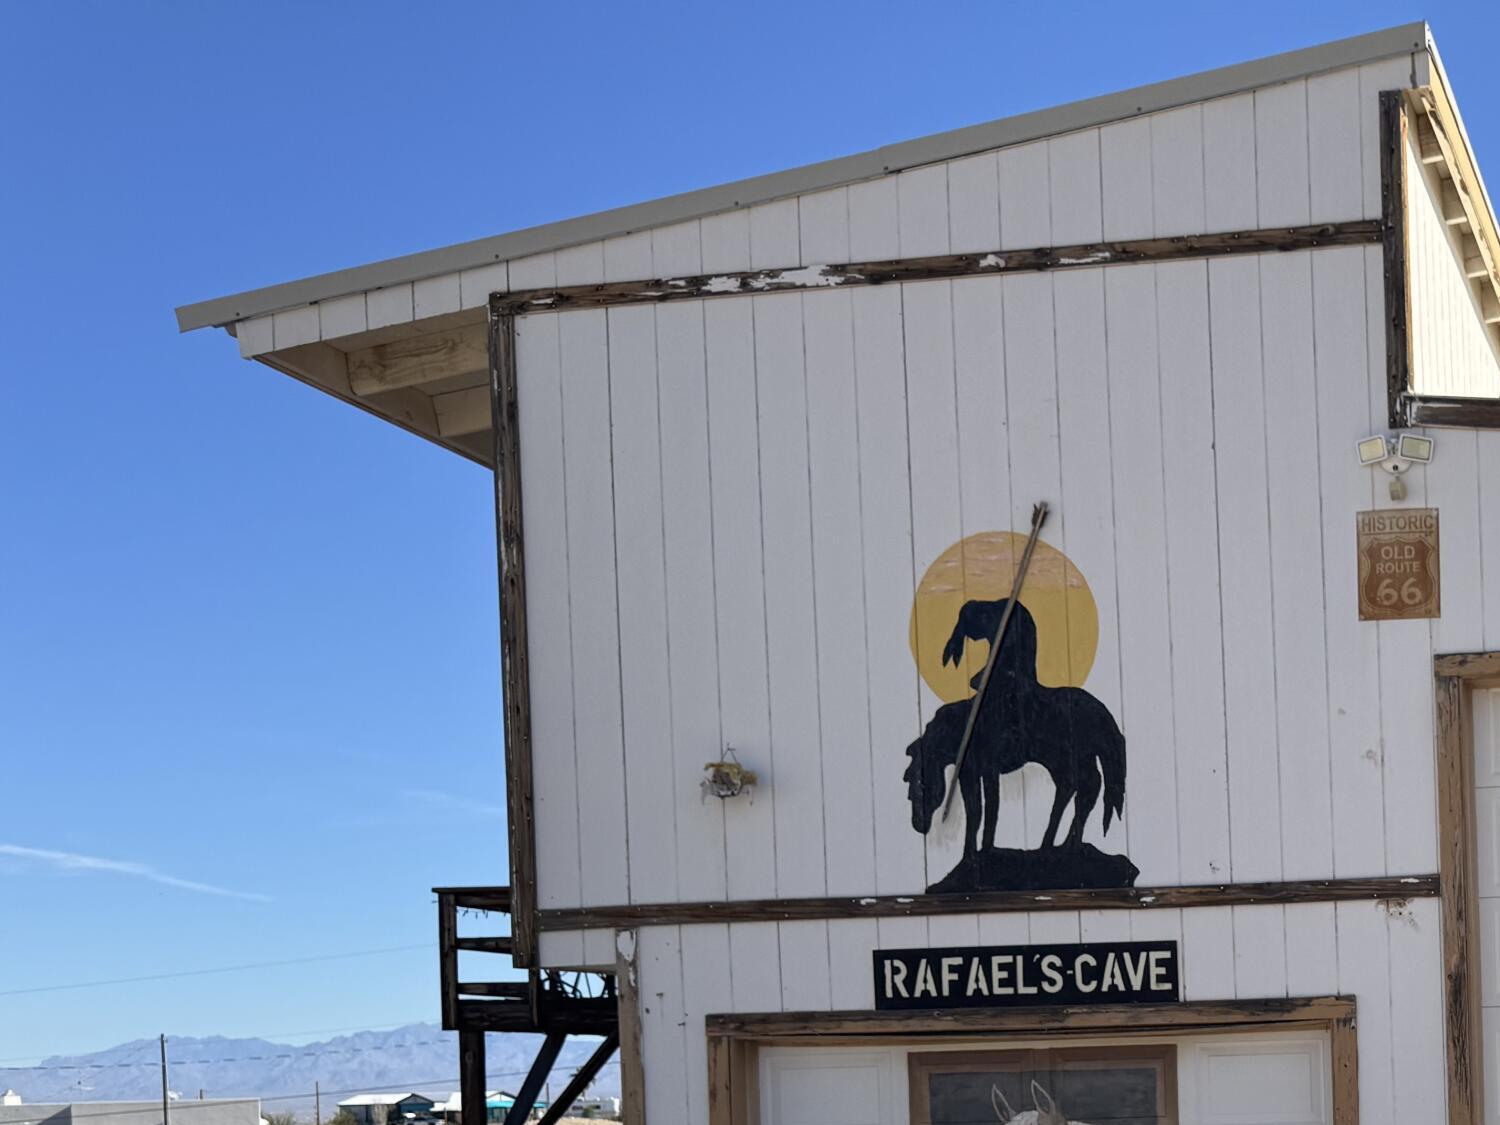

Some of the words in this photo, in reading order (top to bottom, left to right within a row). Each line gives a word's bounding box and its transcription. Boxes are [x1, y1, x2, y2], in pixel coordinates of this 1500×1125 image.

[1362, 515, 1433, 532] HISTORIC
[1381, 546, 1415, 560] OLD
[1376, 562, 1421, 574] ROUTE
[1377, 578, 1422, 605] 66
